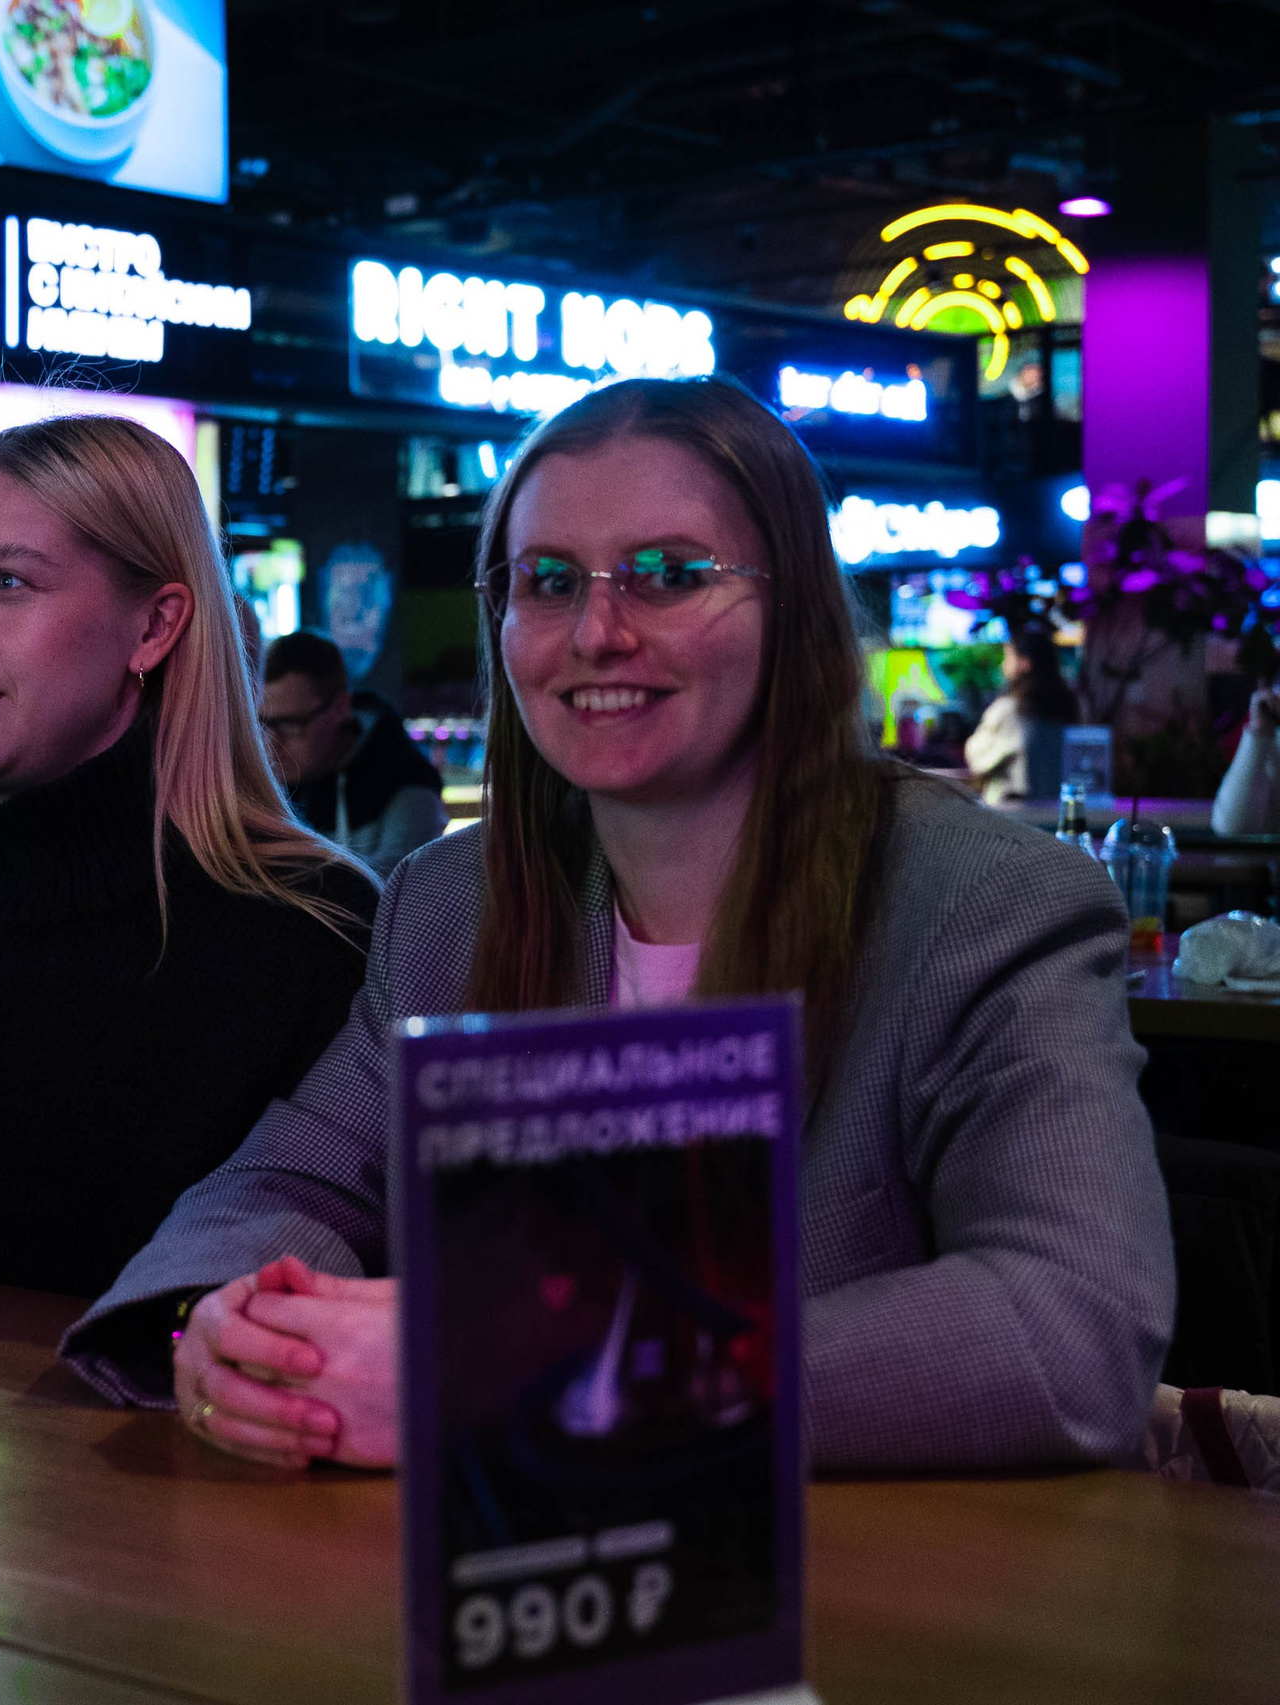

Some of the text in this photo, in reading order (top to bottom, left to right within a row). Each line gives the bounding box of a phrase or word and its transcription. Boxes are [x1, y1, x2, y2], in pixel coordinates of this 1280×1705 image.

[417, 1030, 777, 1110] СПЕЦИАЛЬНОЕ
[417, 1091, 784, 1174] ПРЕДЛОЖЕНИЕ
[452, 1573, 613, 1672] 990
